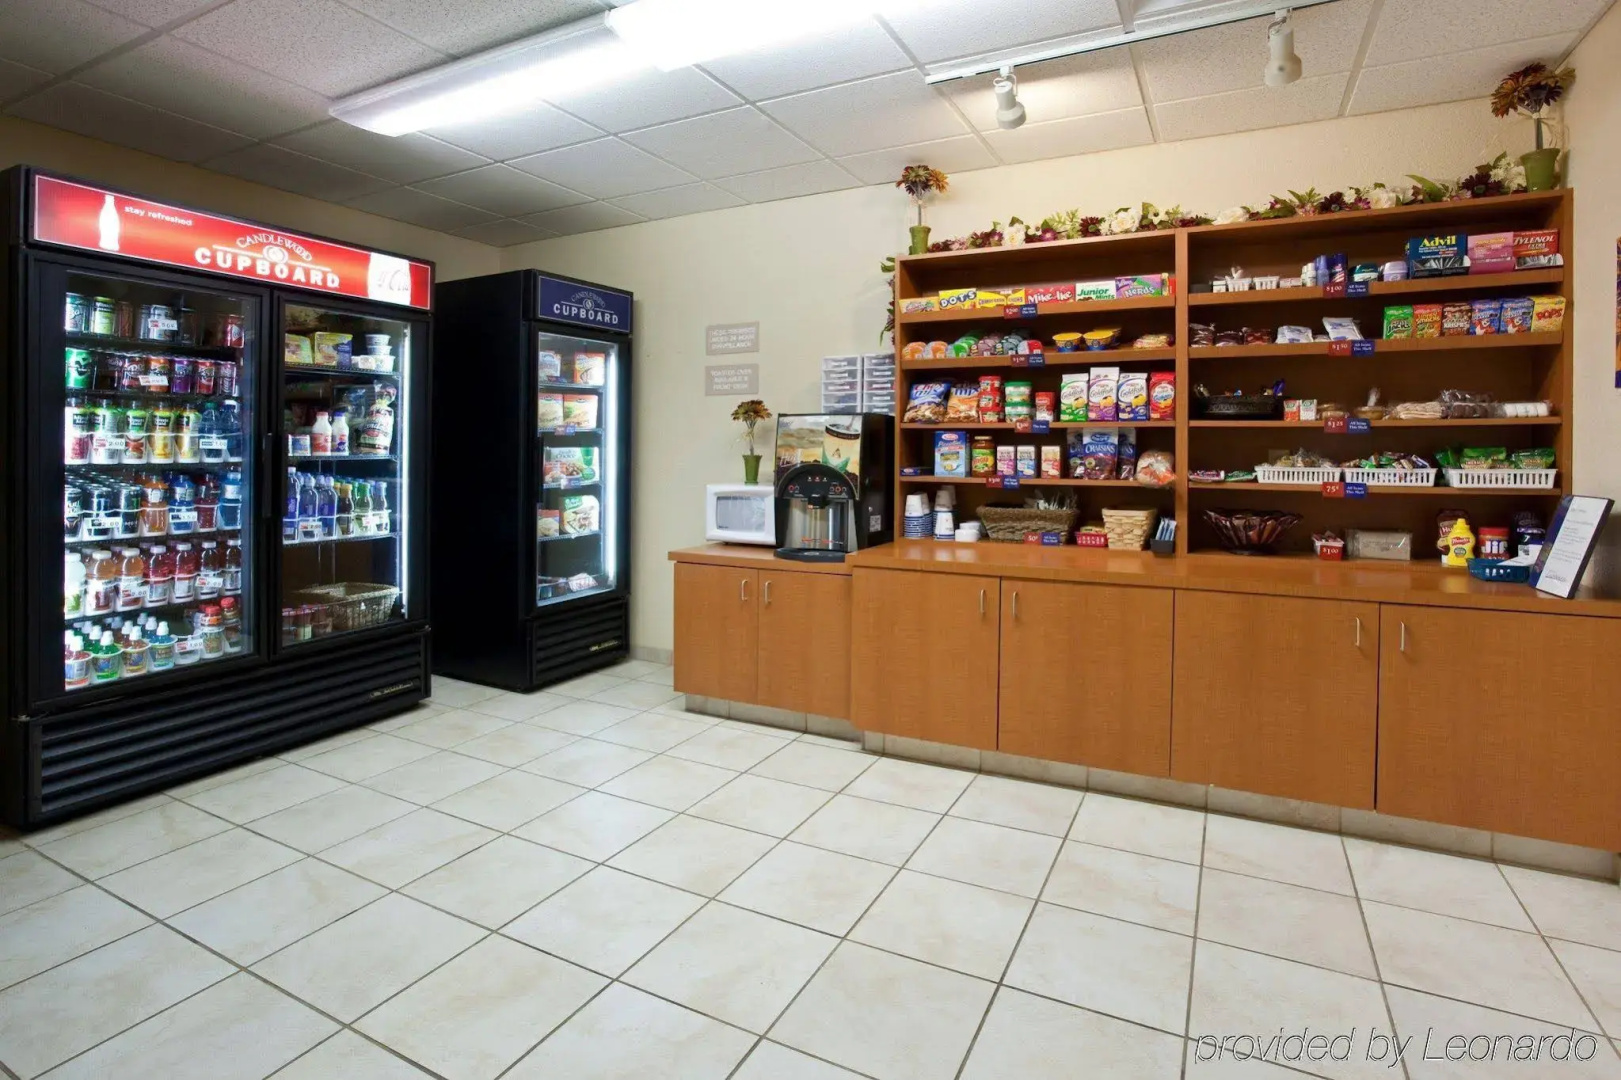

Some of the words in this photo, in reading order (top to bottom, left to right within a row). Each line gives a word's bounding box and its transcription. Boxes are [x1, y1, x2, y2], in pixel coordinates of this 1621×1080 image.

[124, 205, 145, 217] stay
[147, 209, 193, 226] refreshed
[1420, 235, 1457, 247] Advil
[1513, 234, 1556, 245] TYLENOL
[236, 233, 313, 261] CANDLEWOOD
[195, 248, 341, 288] CUPBOARD
[1027, 292, 1053, 304] Mike
[1077, 288, 1109, 297] Junior
[940, 291, 976, 307] DOTS
[553, 303, 619, 324] CUPBOARD
[1536, 308, 1564, 321] POPS
[1062, 388, 1084, 399] Goldfish
[1090, 387, 1114, 399] Goldfish
[1121, 386, 1144, 398] Goldfish
[1085, 444, 1116, 454] CRAISINS
[1481, 540, 1509, 554] Jif
